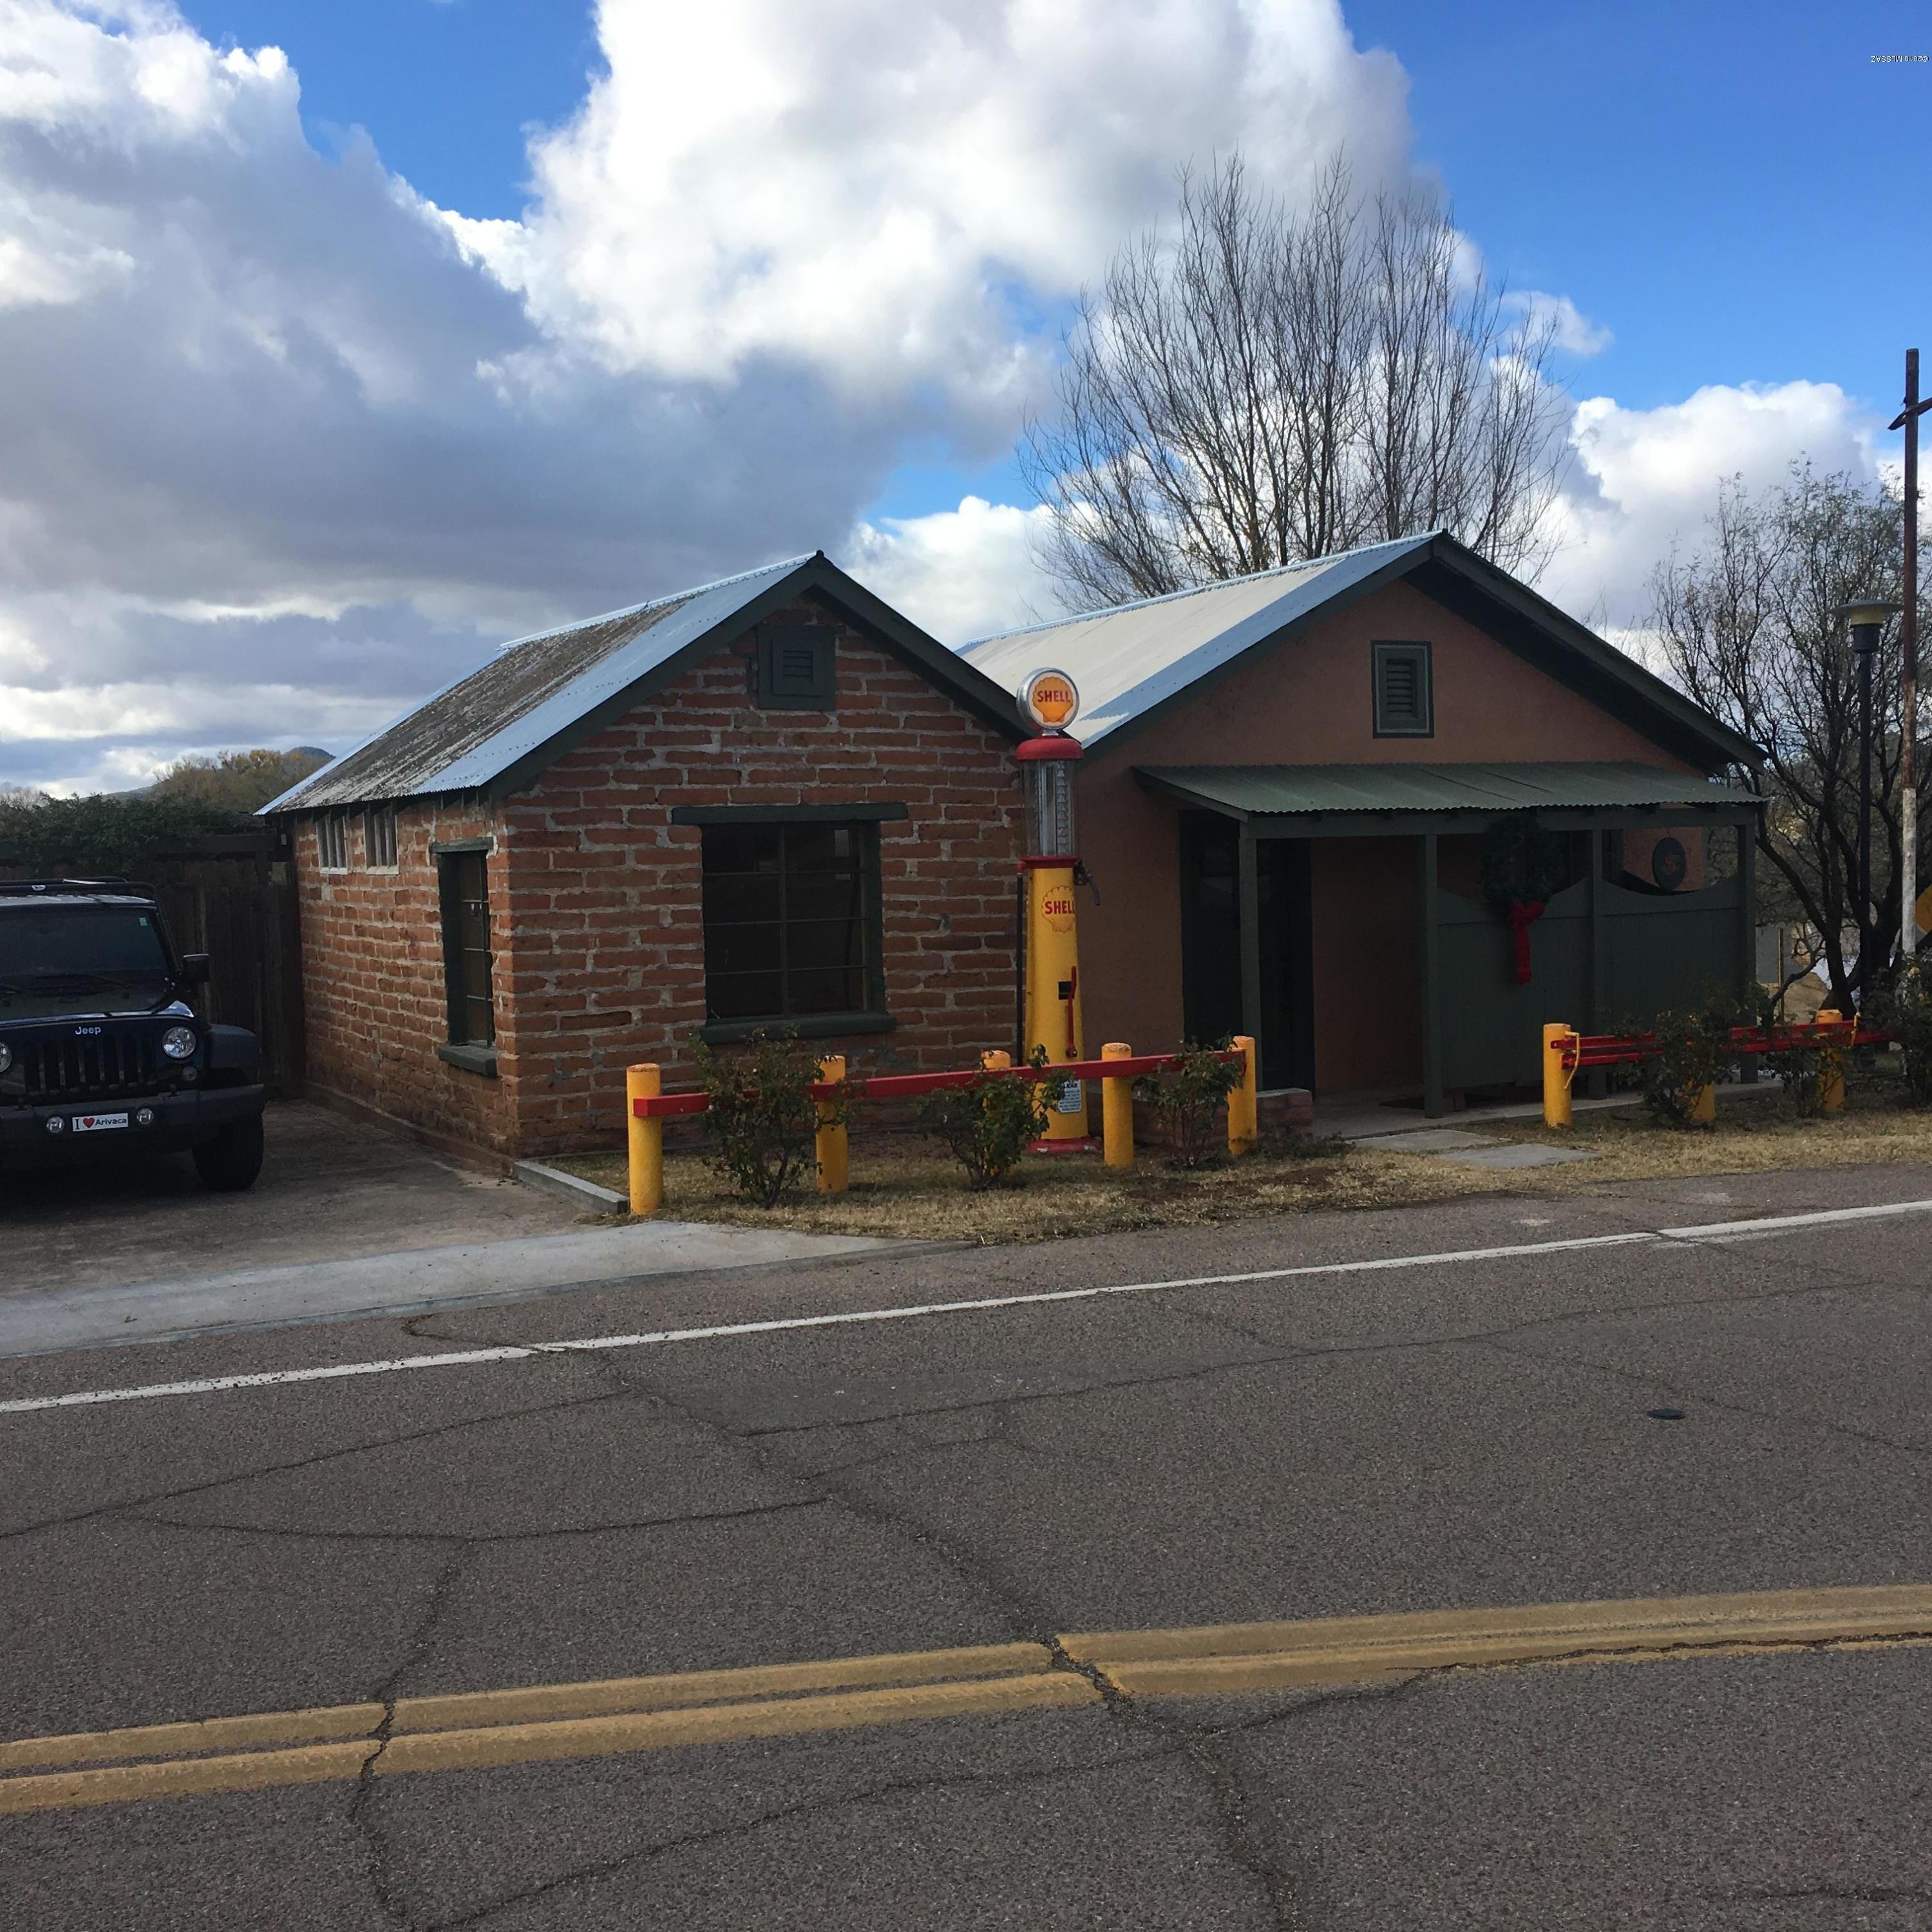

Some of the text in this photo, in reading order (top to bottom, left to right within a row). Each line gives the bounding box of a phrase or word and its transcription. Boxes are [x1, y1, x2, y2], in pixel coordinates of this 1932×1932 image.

[1037, 690, 1070, 703] SHELL
[1045, 900, 1075, 914] SHELL
[75, 1026, 101, 1035] Jeep
[75, 1119, 80, 1130] I
